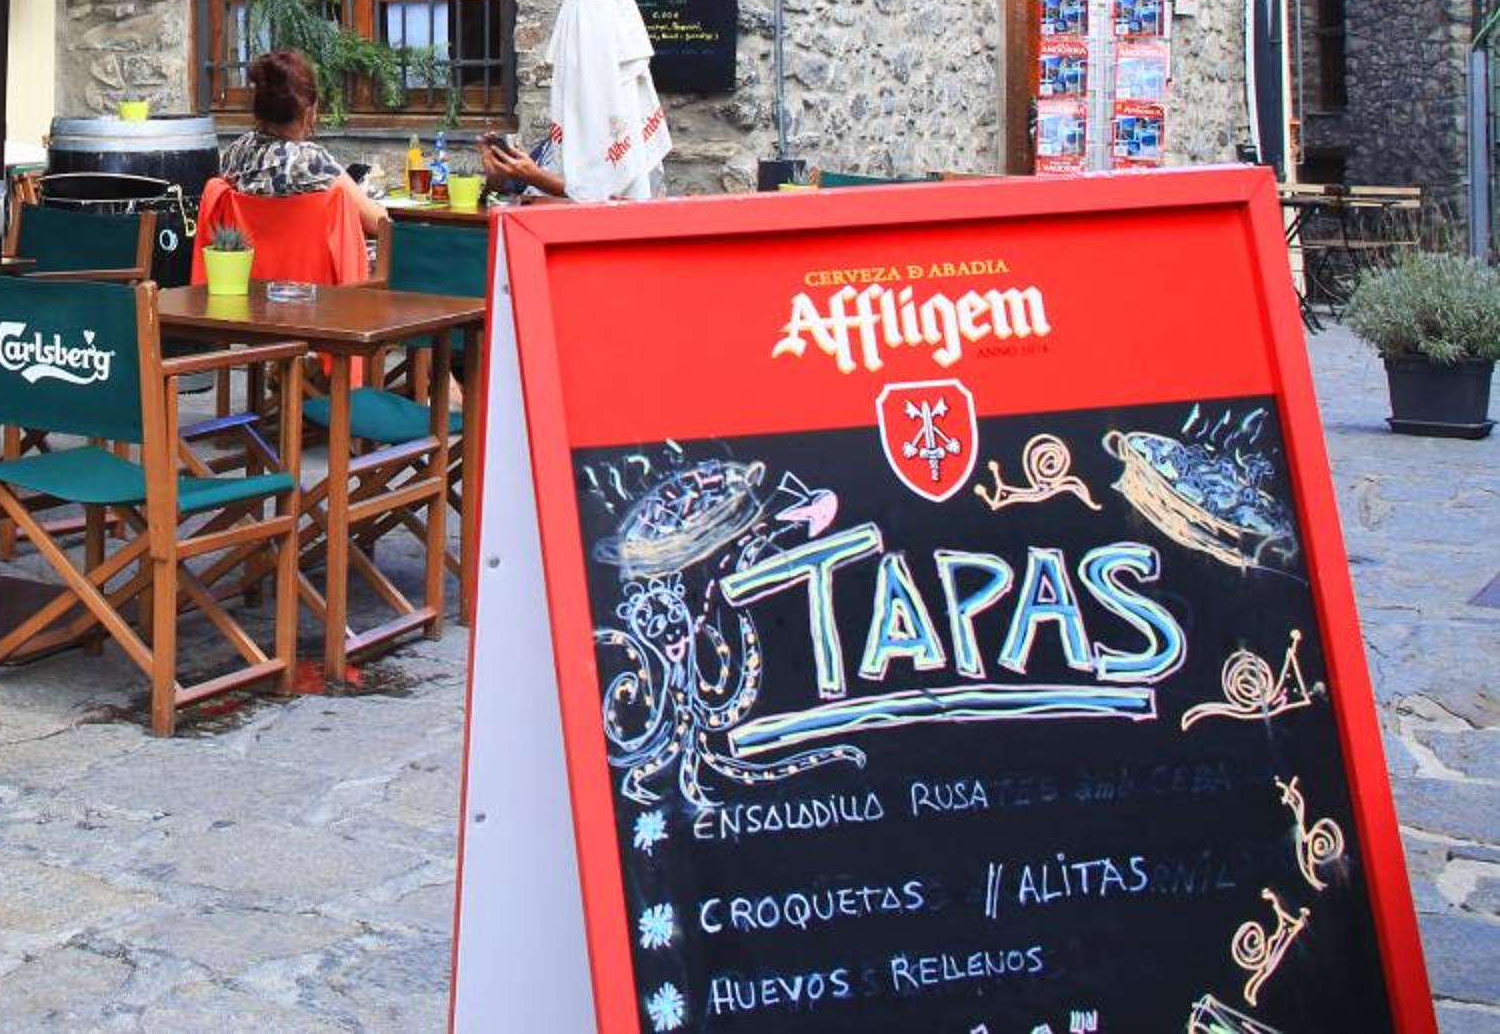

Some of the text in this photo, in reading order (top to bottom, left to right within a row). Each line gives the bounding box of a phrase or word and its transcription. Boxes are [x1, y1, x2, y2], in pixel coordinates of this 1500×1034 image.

[803, 267, 902, 287] CERVEZA
[929, 258, 1010, 279] ABADIA
[771, 284, 1052, 375] Affligem
[721, 522, 1187, 699] TAPAS
[694, 778, 989, 841] ENSALADILLA RUSA
[700, 880, 925, 934] CROQUETAS
[1018, 853, 1149, 907] ALITAS
[710, 945, 1045, 1016] HUEVOS RELLENOS
